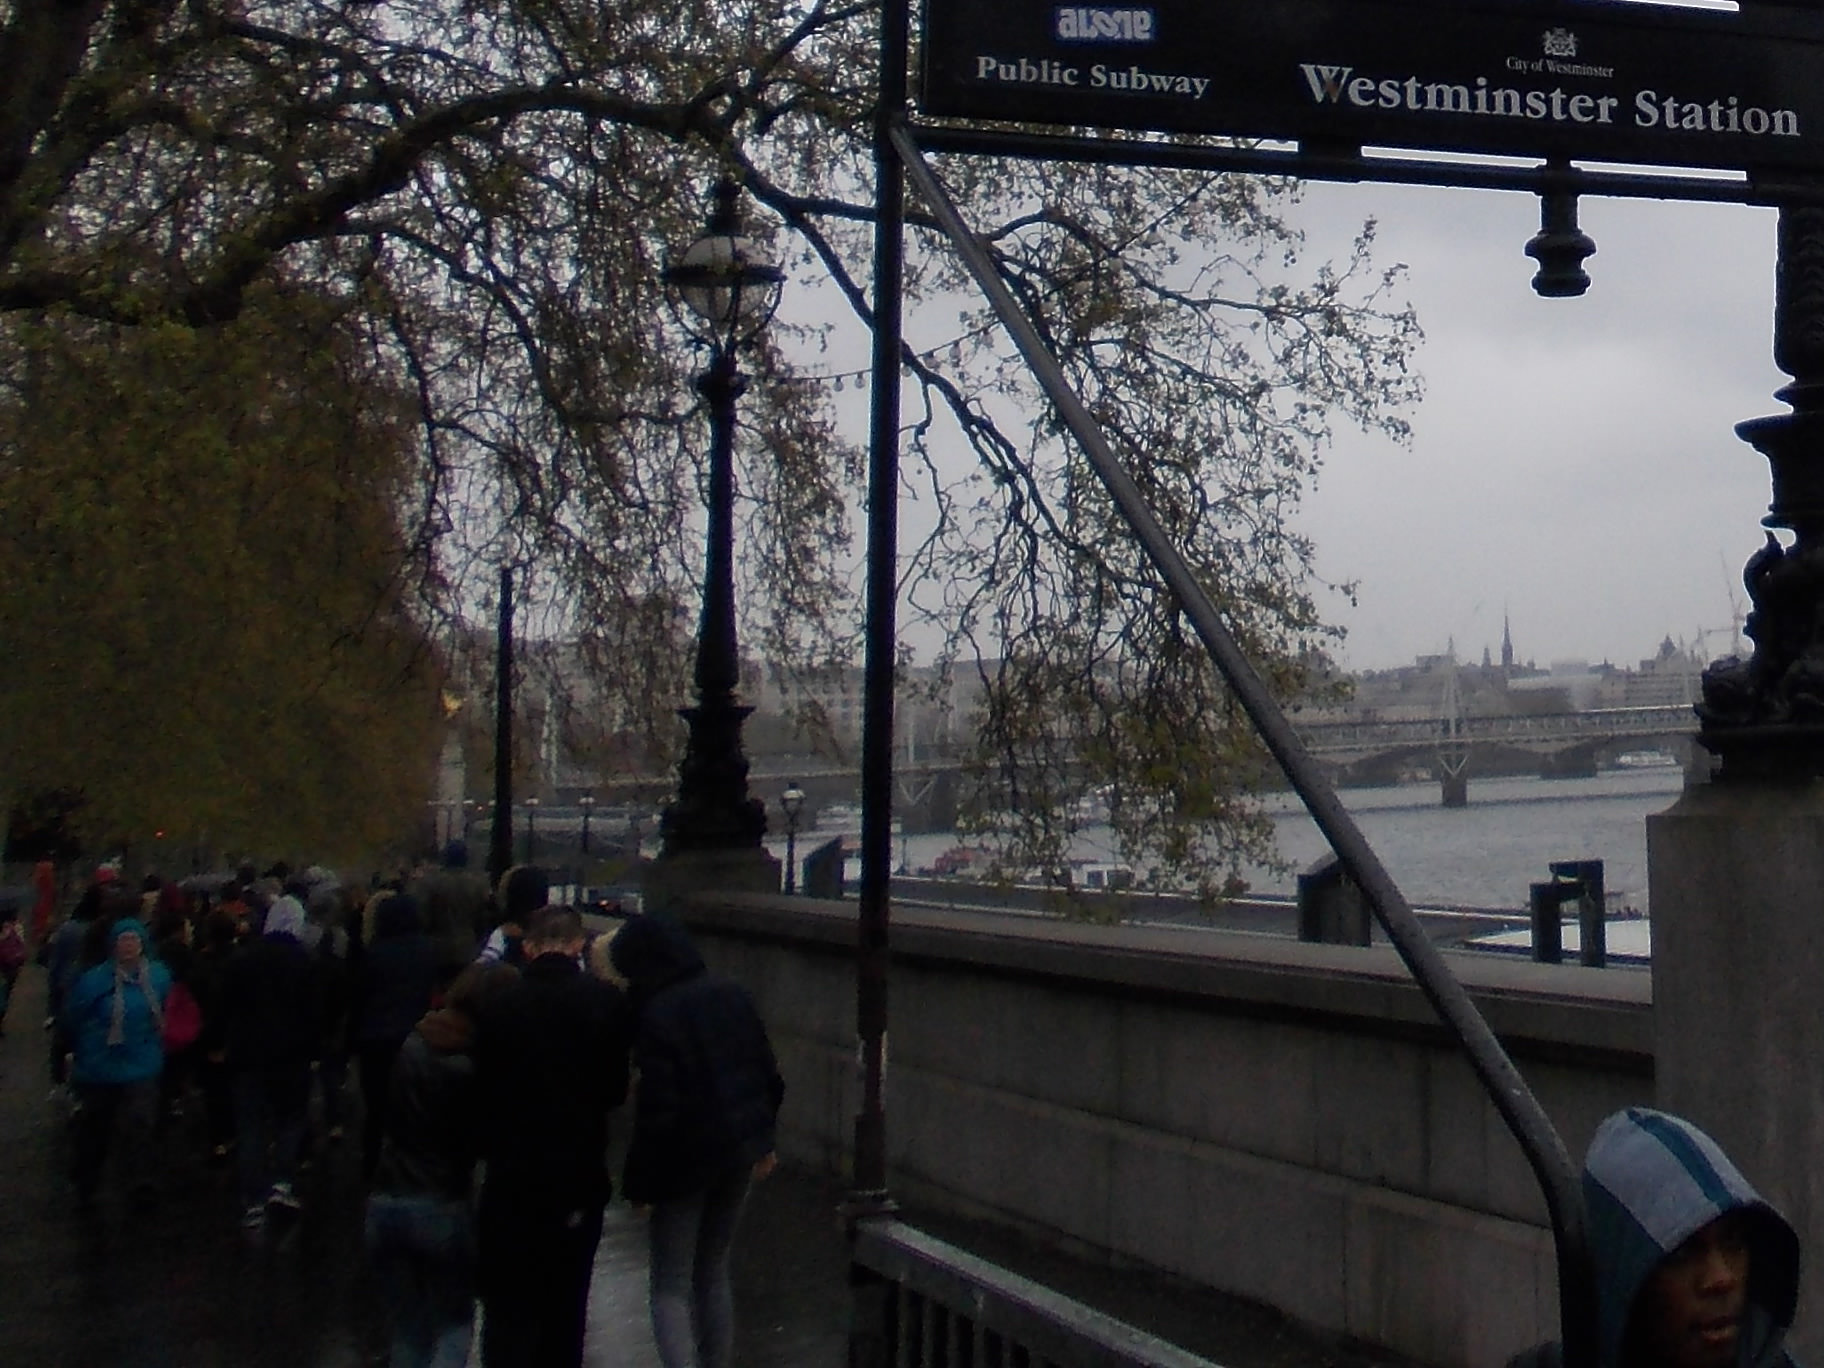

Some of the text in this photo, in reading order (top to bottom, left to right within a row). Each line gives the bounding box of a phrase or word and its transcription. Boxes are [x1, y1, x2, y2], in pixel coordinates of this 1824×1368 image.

[976, 55, 1211, 100] Public Subway
[1505, 55, 1614, 78] City of Westminster
[1300, 63, 1800, 137] Westminster Station
